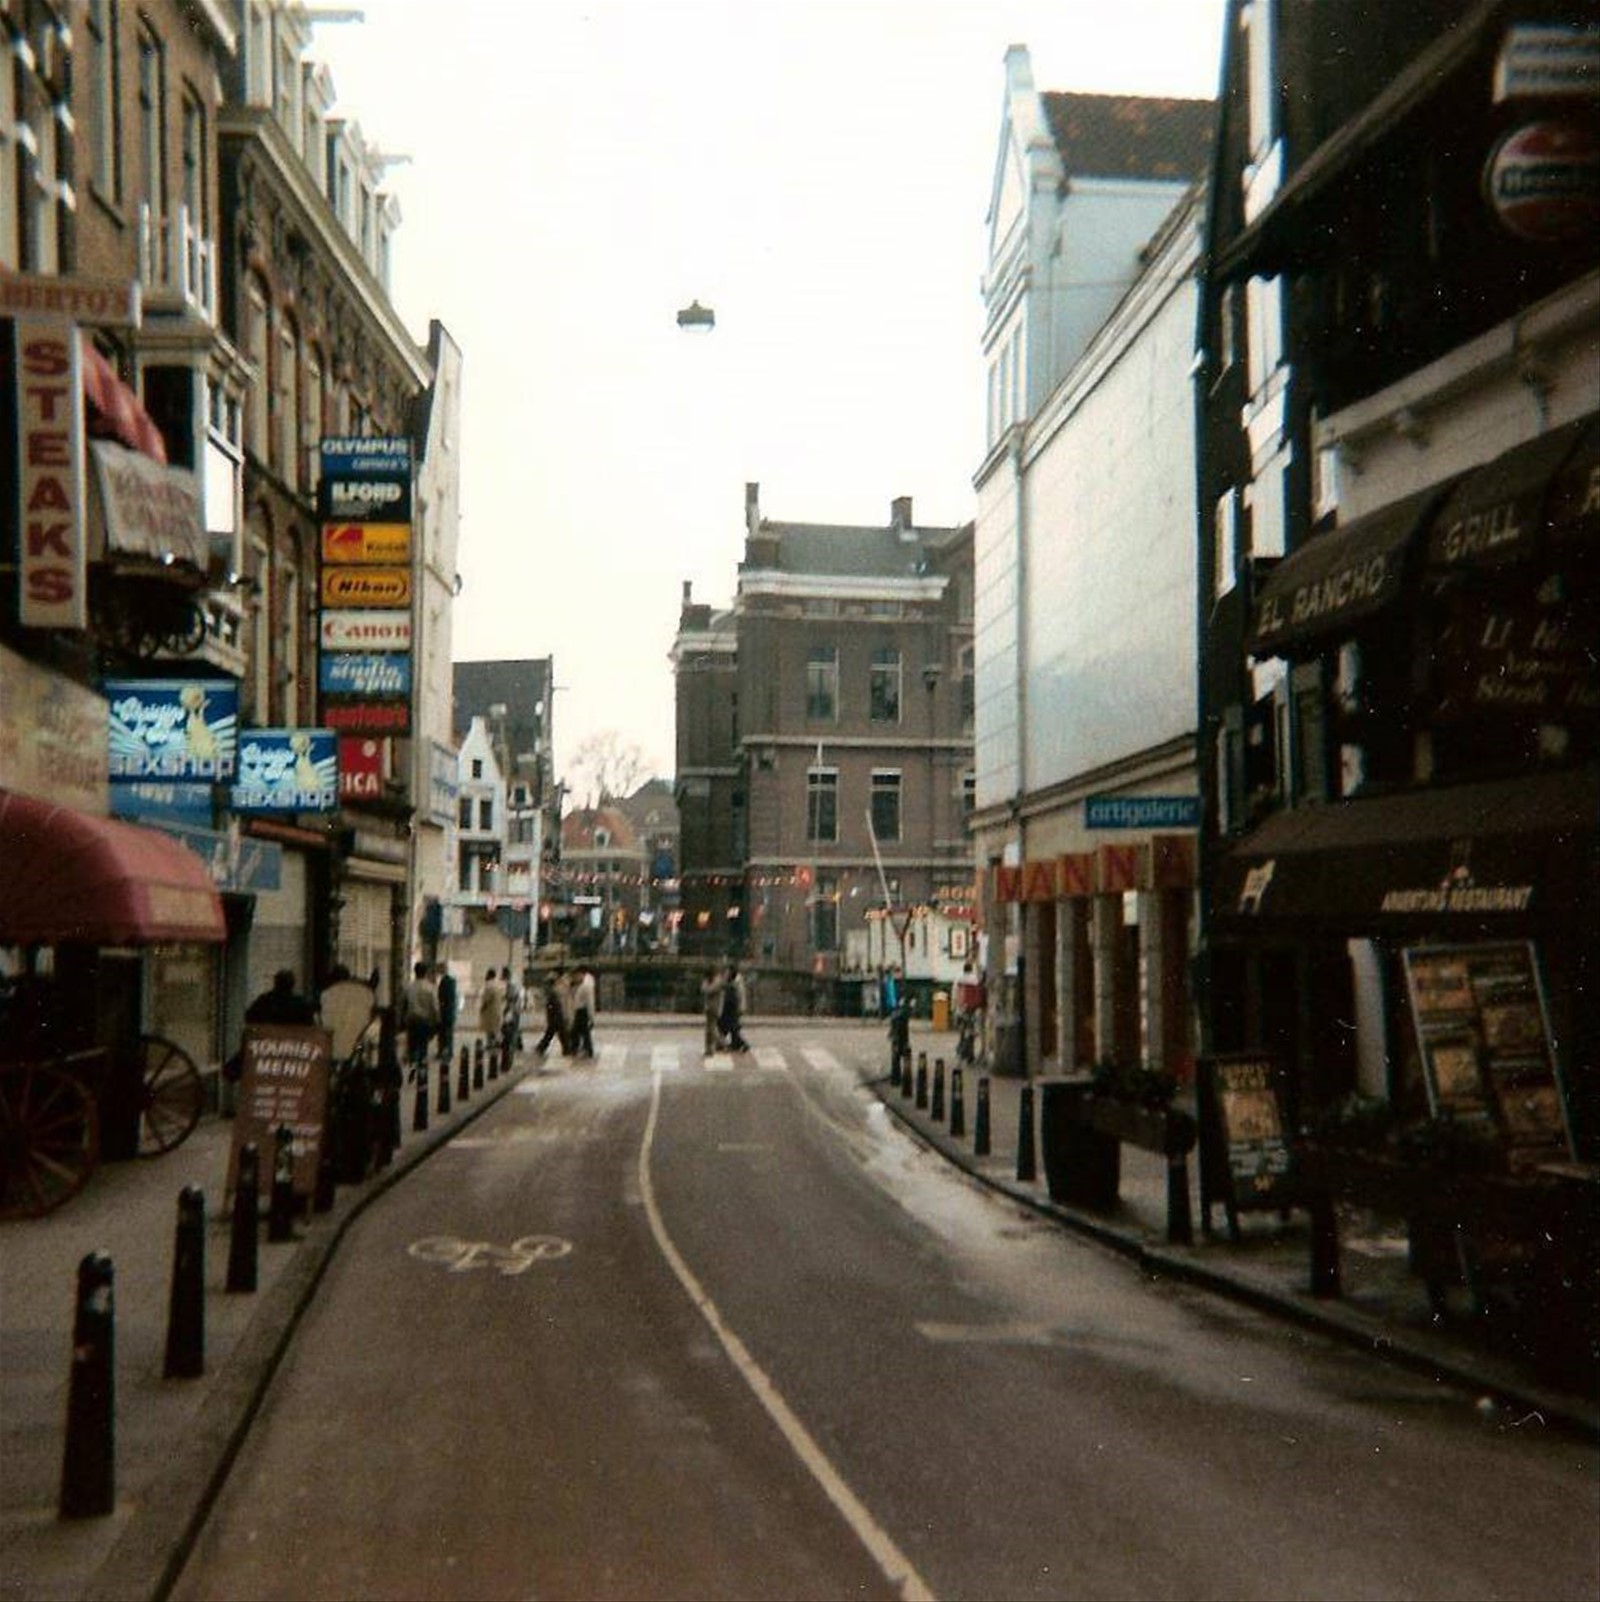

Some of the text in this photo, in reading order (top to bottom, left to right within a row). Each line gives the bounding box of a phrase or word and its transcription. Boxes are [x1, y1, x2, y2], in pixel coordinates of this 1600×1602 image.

[322, 437, 408, 455] OLYMPUS
[24, 338, 74, 603] STEAKS
[331, 482, 402, 502] ILFORD
[1445, 504, 1520, 561] GRILL
[337, 578, 400, 594] Nikon
[1257, 555, 1387, 637] EL RANCHO
[323, 620, 411, 639] Canon
[108, 752, 235, 782] sexshop
[340, 771, 378, 793] ICA
[231, 785, 336, 811] sexshop
[1090, 799, 1195, 825] artigalerie
[249, 1039, 323, 1061] TOURIST
[256, 1059, 311, 1079] MENU
